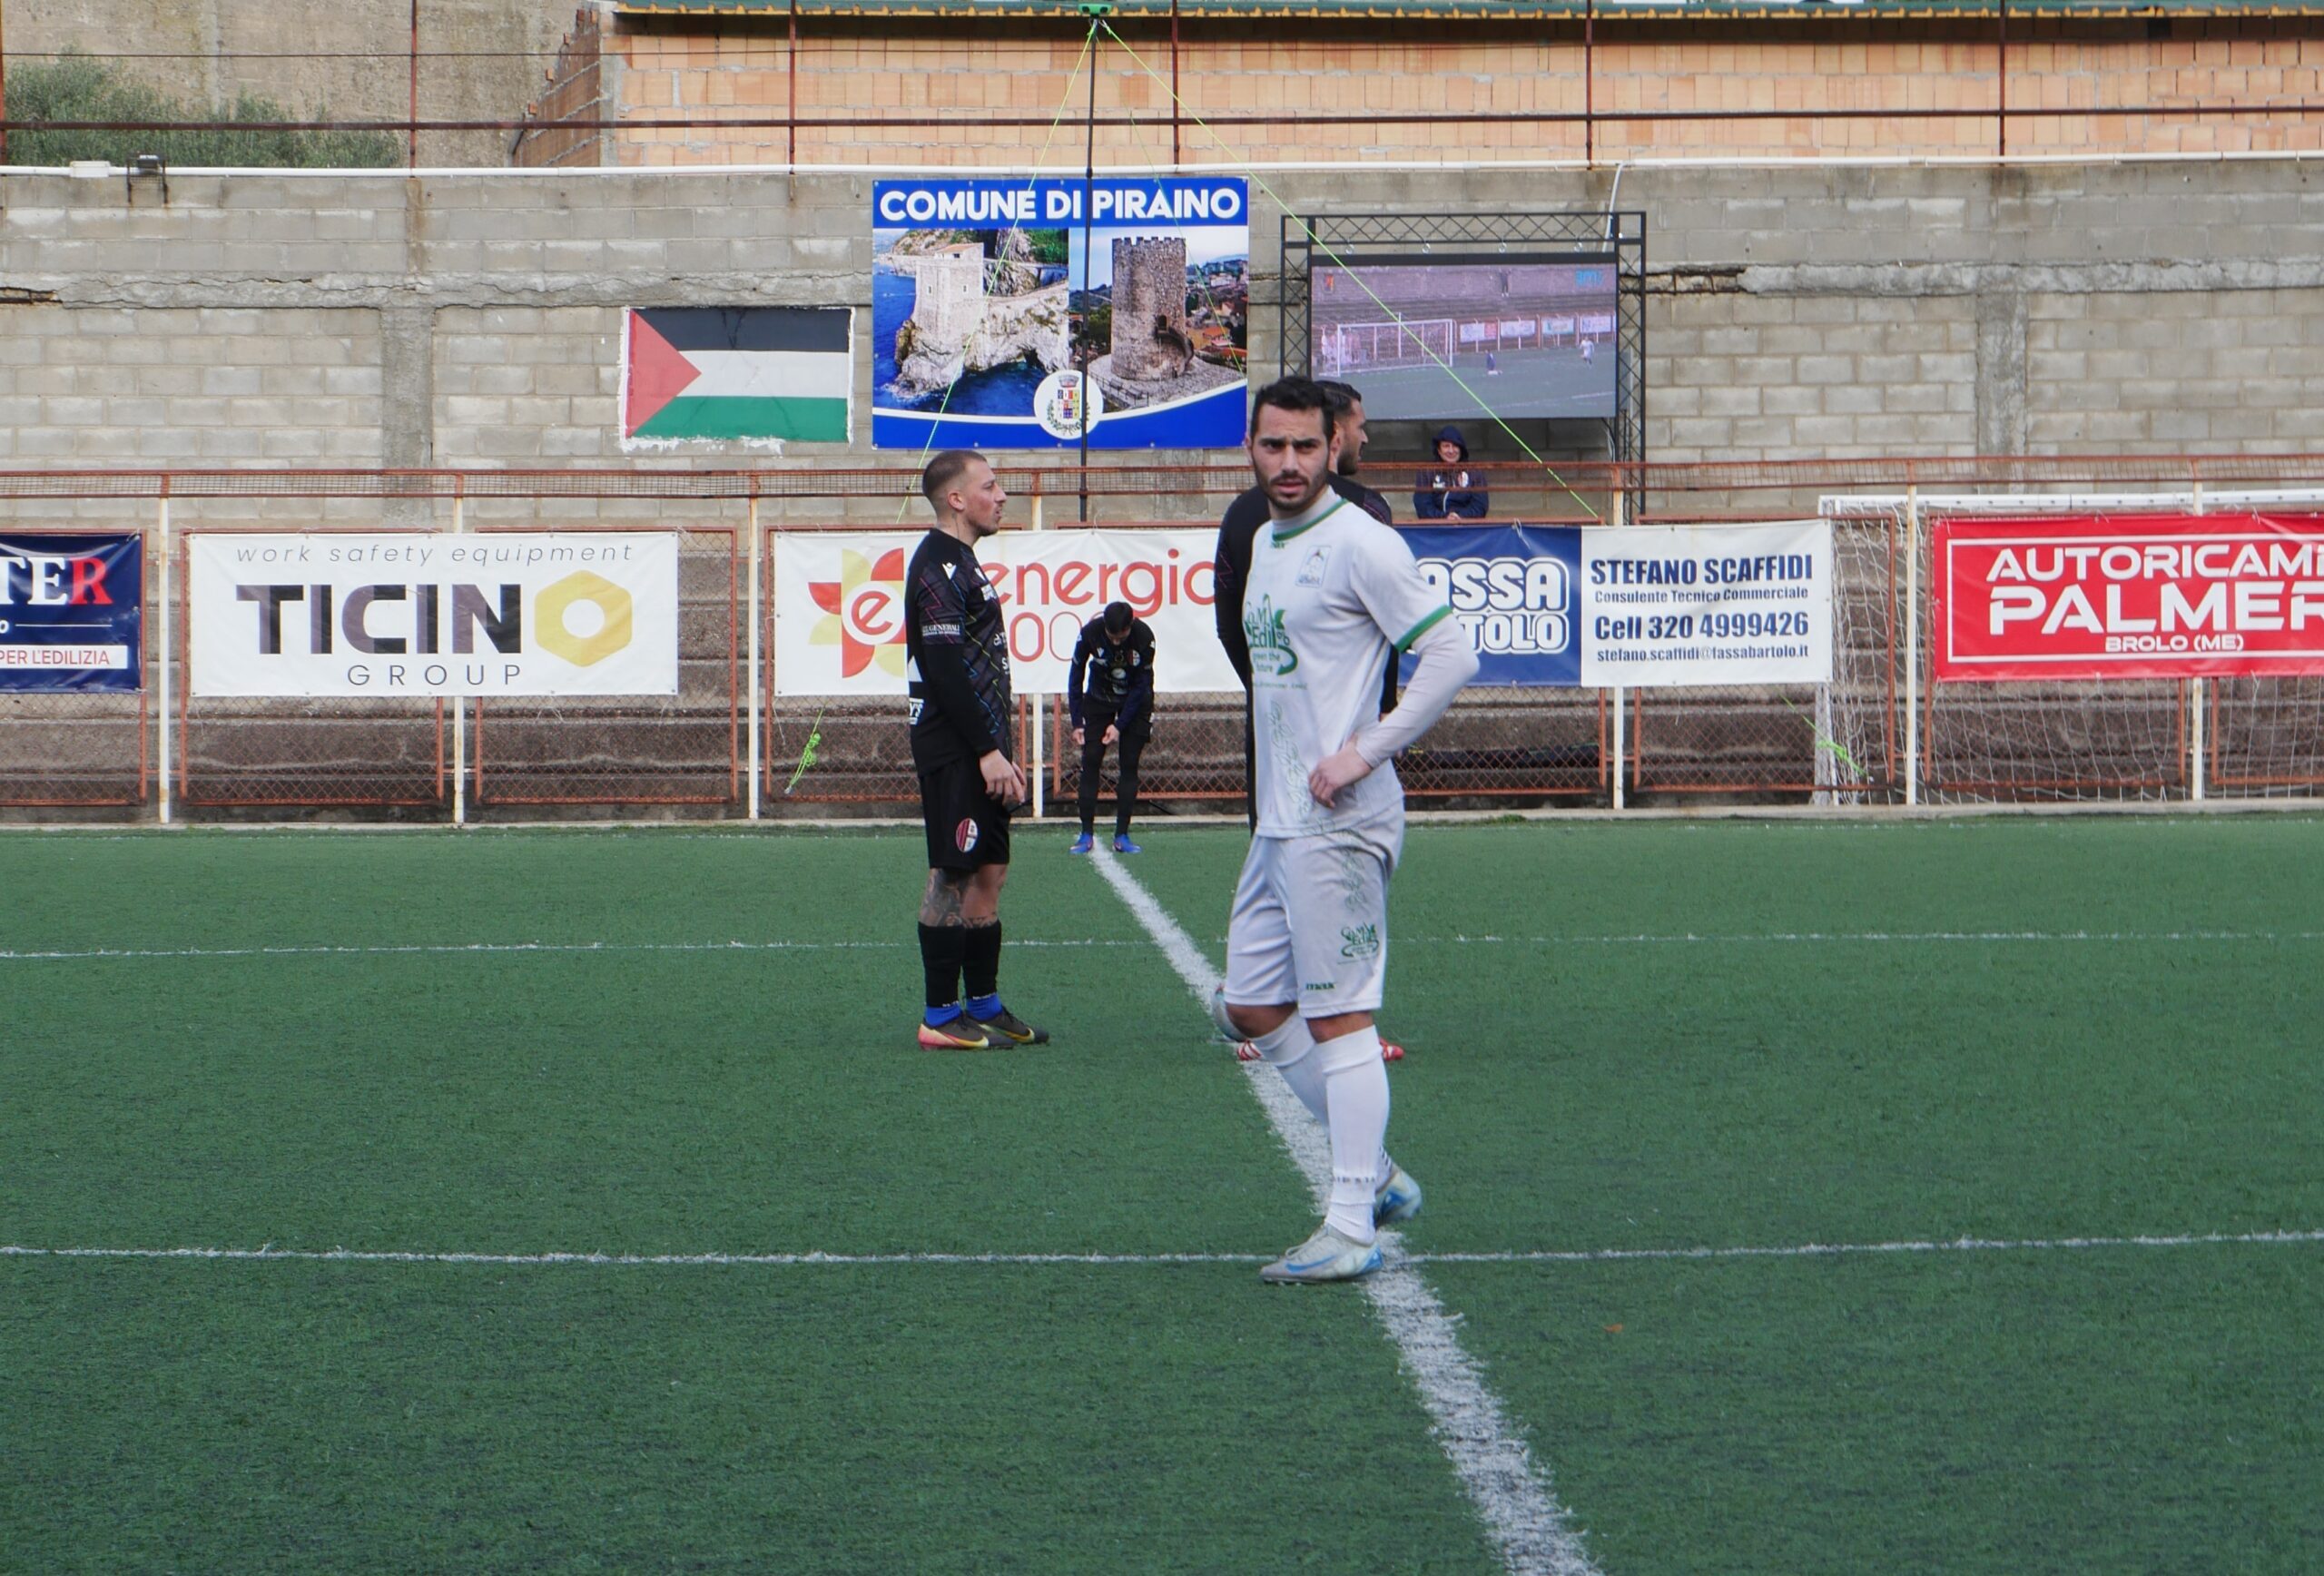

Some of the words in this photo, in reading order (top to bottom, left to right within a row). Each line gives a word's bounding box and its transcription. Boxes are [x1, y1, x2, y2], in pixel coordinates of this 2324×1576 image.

[881, 190, 1036, 222] COMUNE
[1047, 190, 1081, 220] DI
[1093, 188, 1240, 219] PIRAINO
[237, 545, 310, 562] work
[330, 544, 433, 566] safety
[451, 544, 633, 566] equipment
[1986, 543, 2324, 582] AUTORICAM
[1417, 558, 1567, 611] ASSA
[1590, 559, 1698, 586] STEFANO
[1704, 555, 1812, 584] SCAFFIDI
[1595, 590, 1668, 604] Consulente
[1670, 589, 1720, 603] Tecnico
[1723, 586, 1808, 601] Commerciale
[1457, 613, 1567, 653] TOLO
[1595, 616, 1642, 640] Cell
[1648, 615, 1694, 639] 320
[1699, 612, 1808, 638] 4999426
[1598, 645, 1808, 662] stefano.scaffidi@fassabartolo.it
[2105, 635, 2189, 653] BROLO
[2193, 634, 2244, 653] (ME)
[347, 665, 521, 686] GROUP
